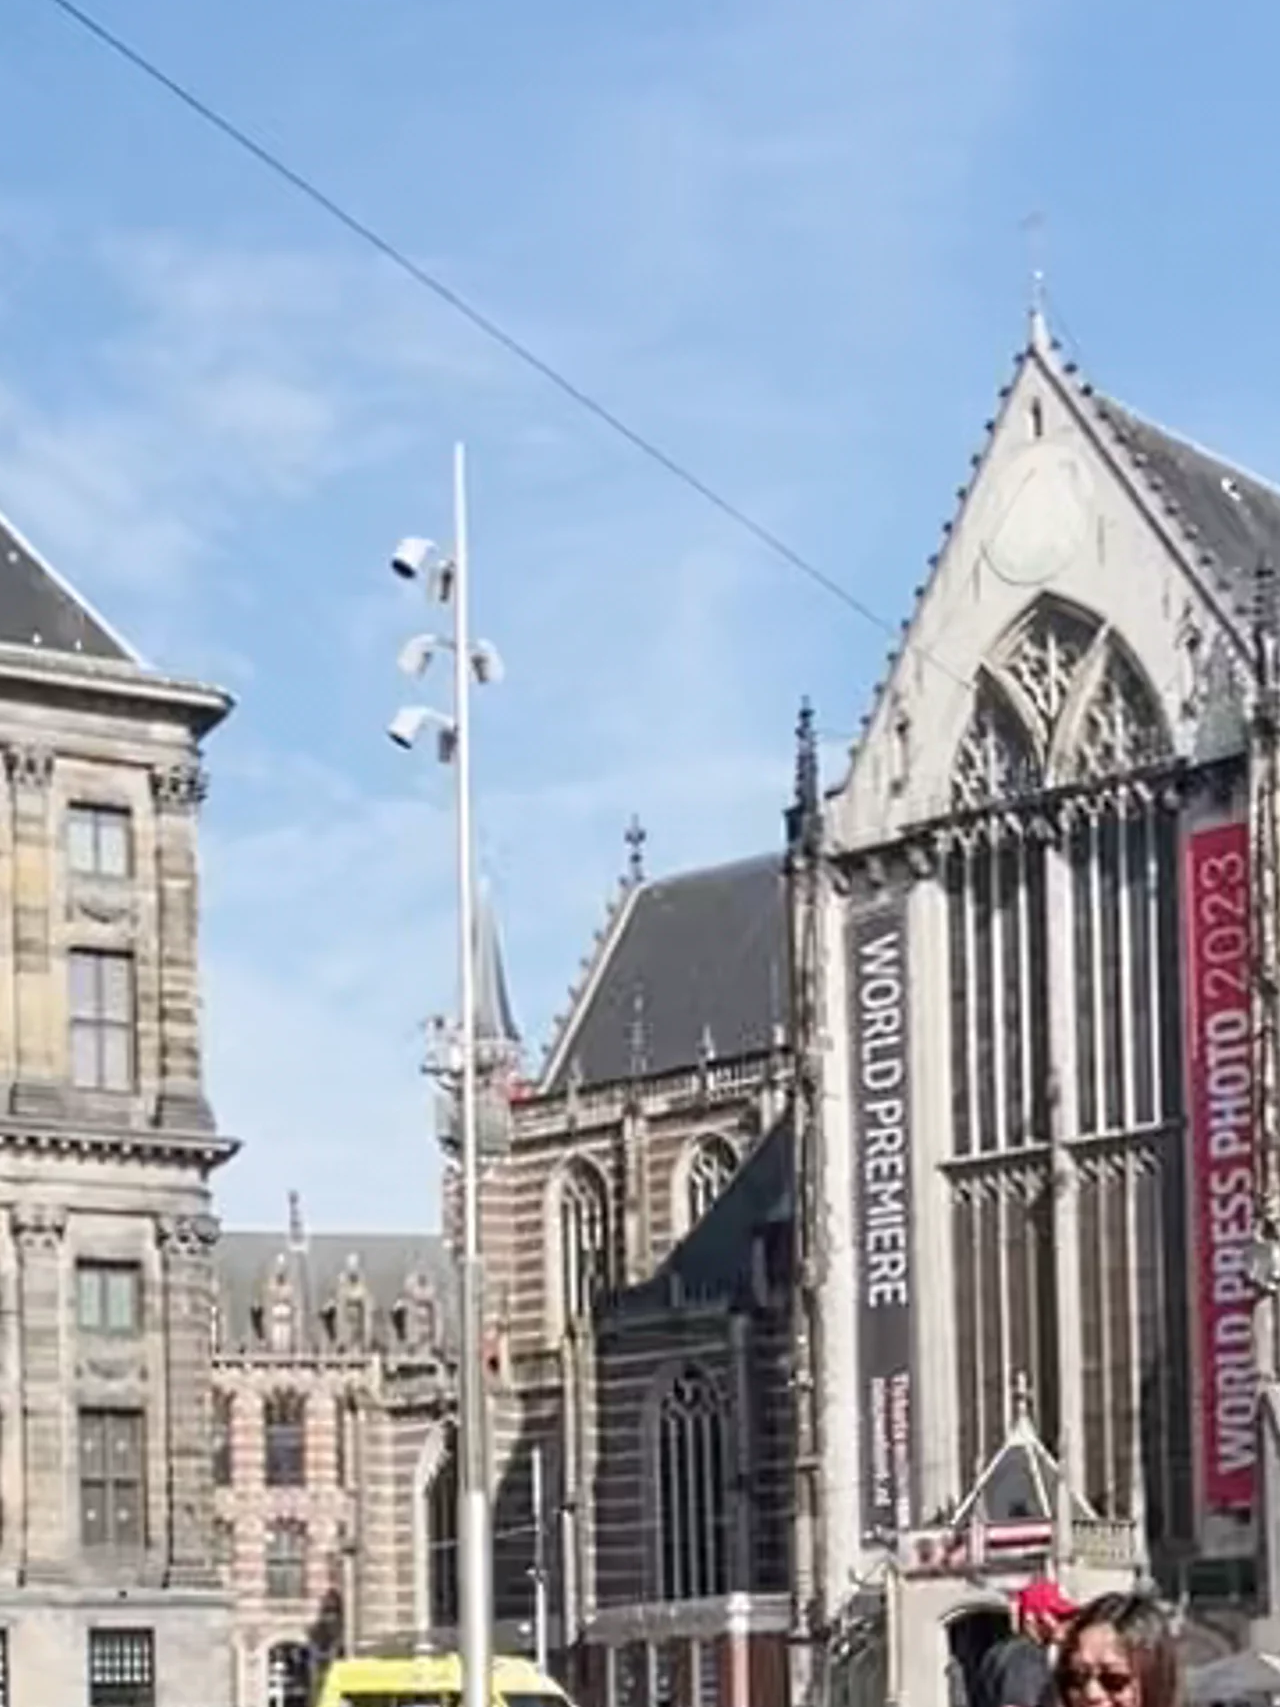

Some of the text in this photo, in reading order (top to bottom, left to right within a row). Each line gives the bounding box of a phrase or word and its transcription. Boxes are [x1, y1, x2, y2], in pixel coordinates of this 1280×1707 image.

[858, 931, 908, 1309] WORLD PREMIERE
[1199, 850, 1258, 1476] WORLD PRESS PHOTO 2023
